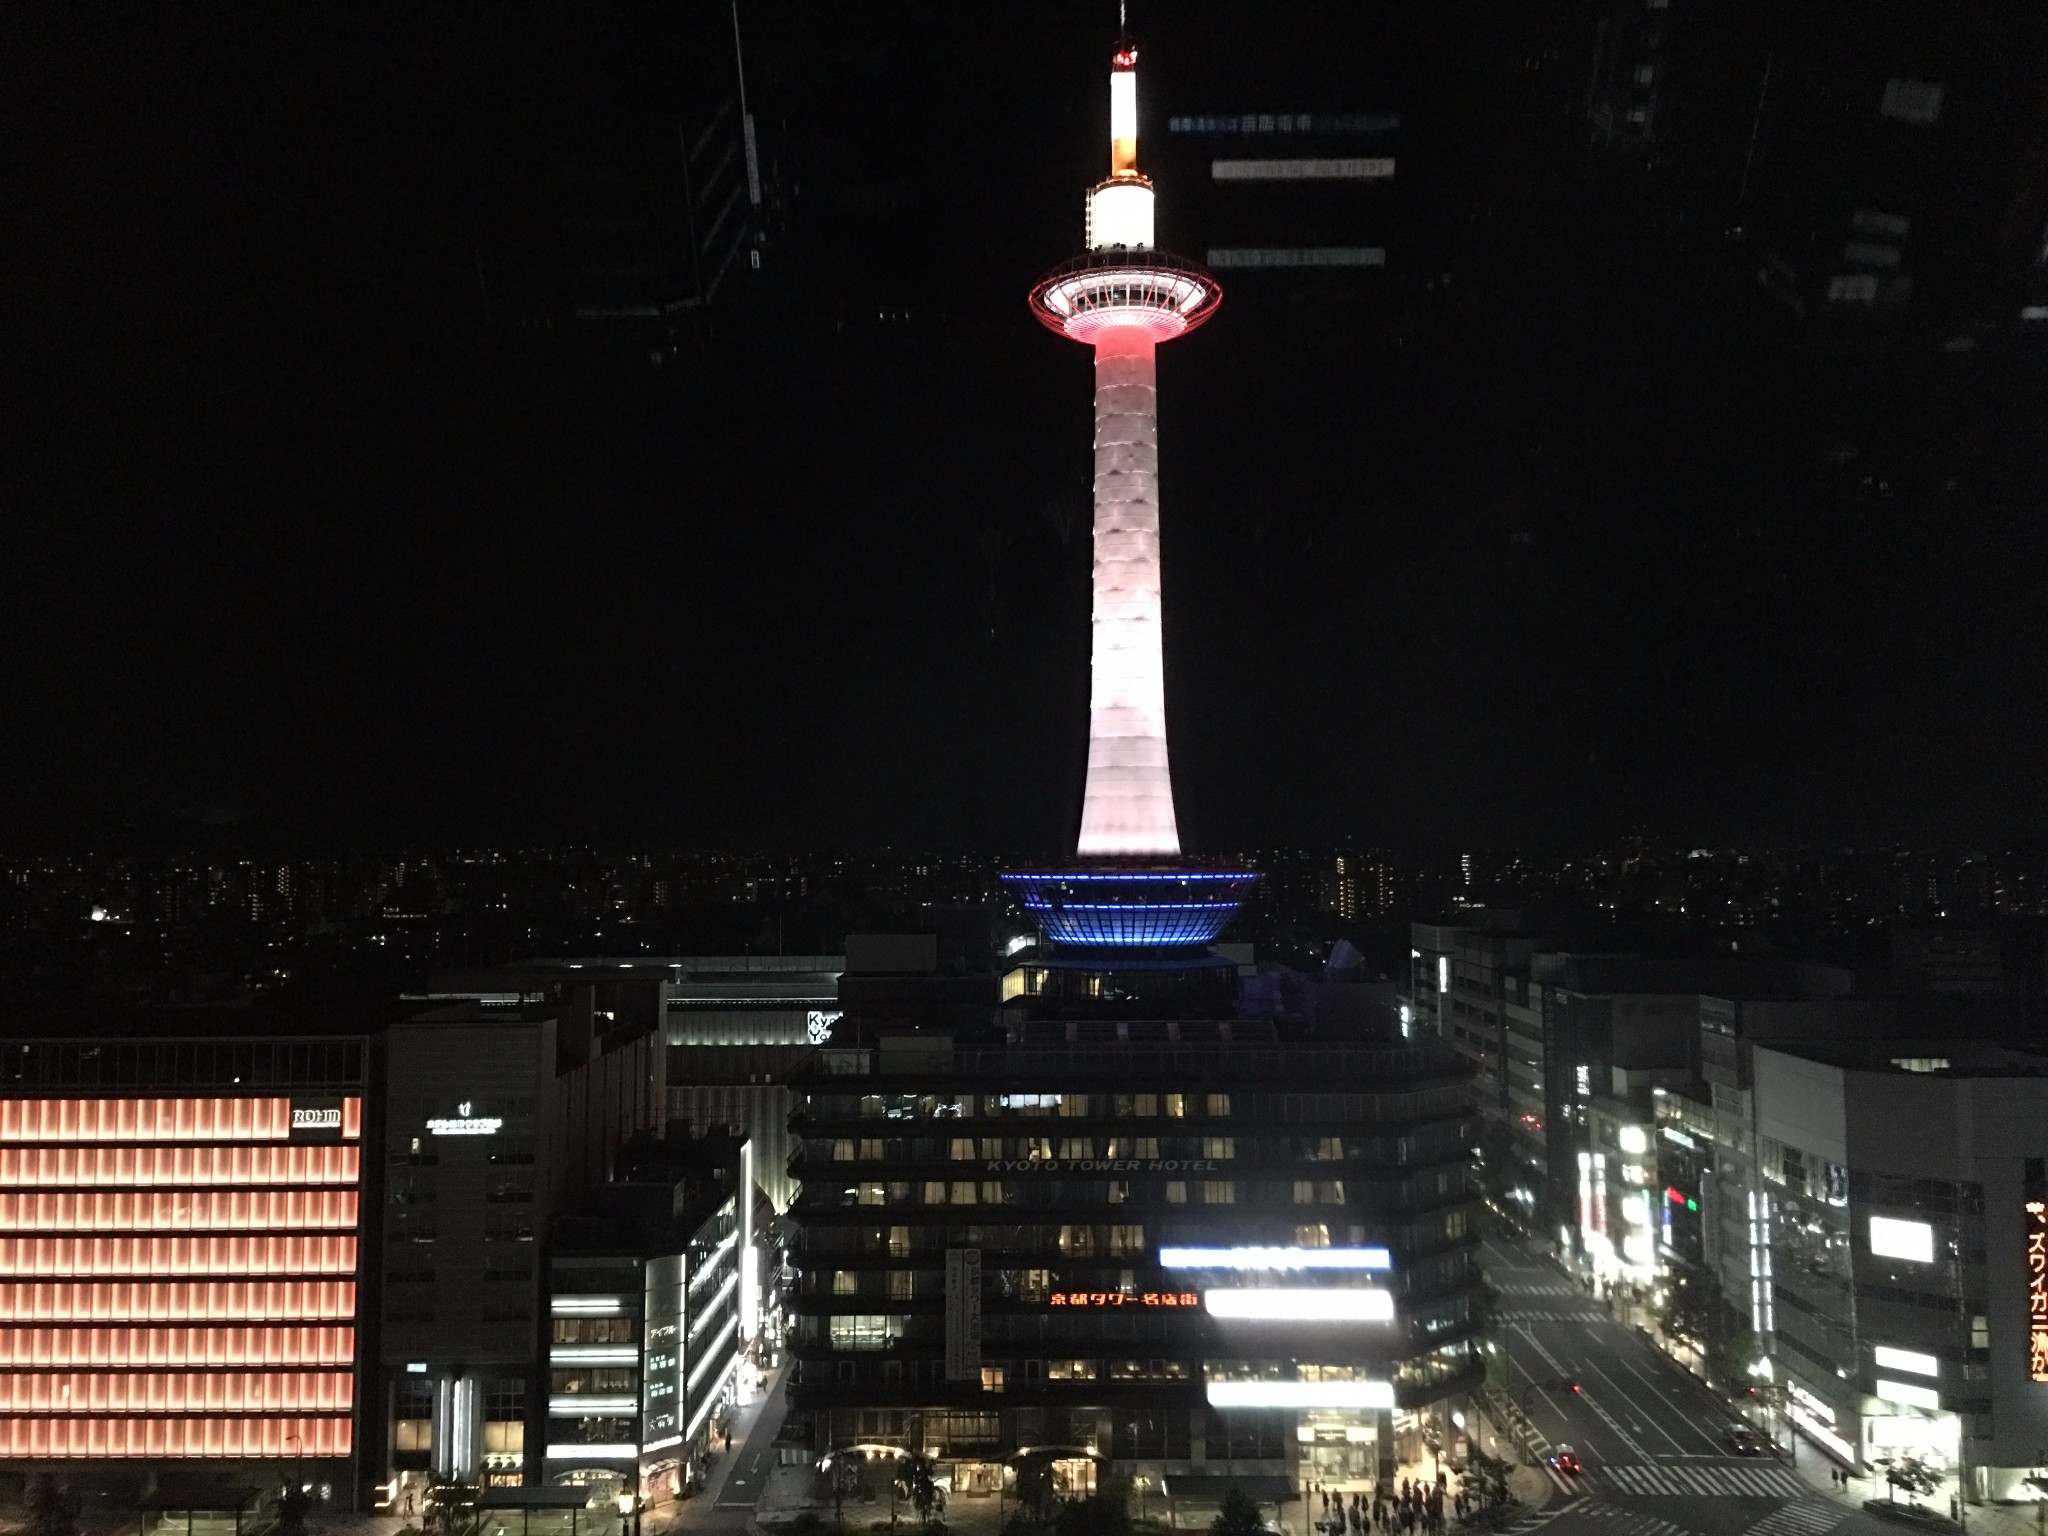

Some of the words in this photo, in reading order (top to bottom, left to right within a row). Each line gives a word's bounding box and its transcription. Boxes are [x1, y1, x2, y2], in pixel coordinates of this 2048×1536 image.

[292, 1109, 341, 1122] ROHM
[986, 1159, 1059, 1171] KYOTO
[1068, 1159, 1141, 1171] TOWER
[1149, 1159, 1219, 1171] HOTEL
[1050, 1293, 1198, 1306] 京都タワー名店街
